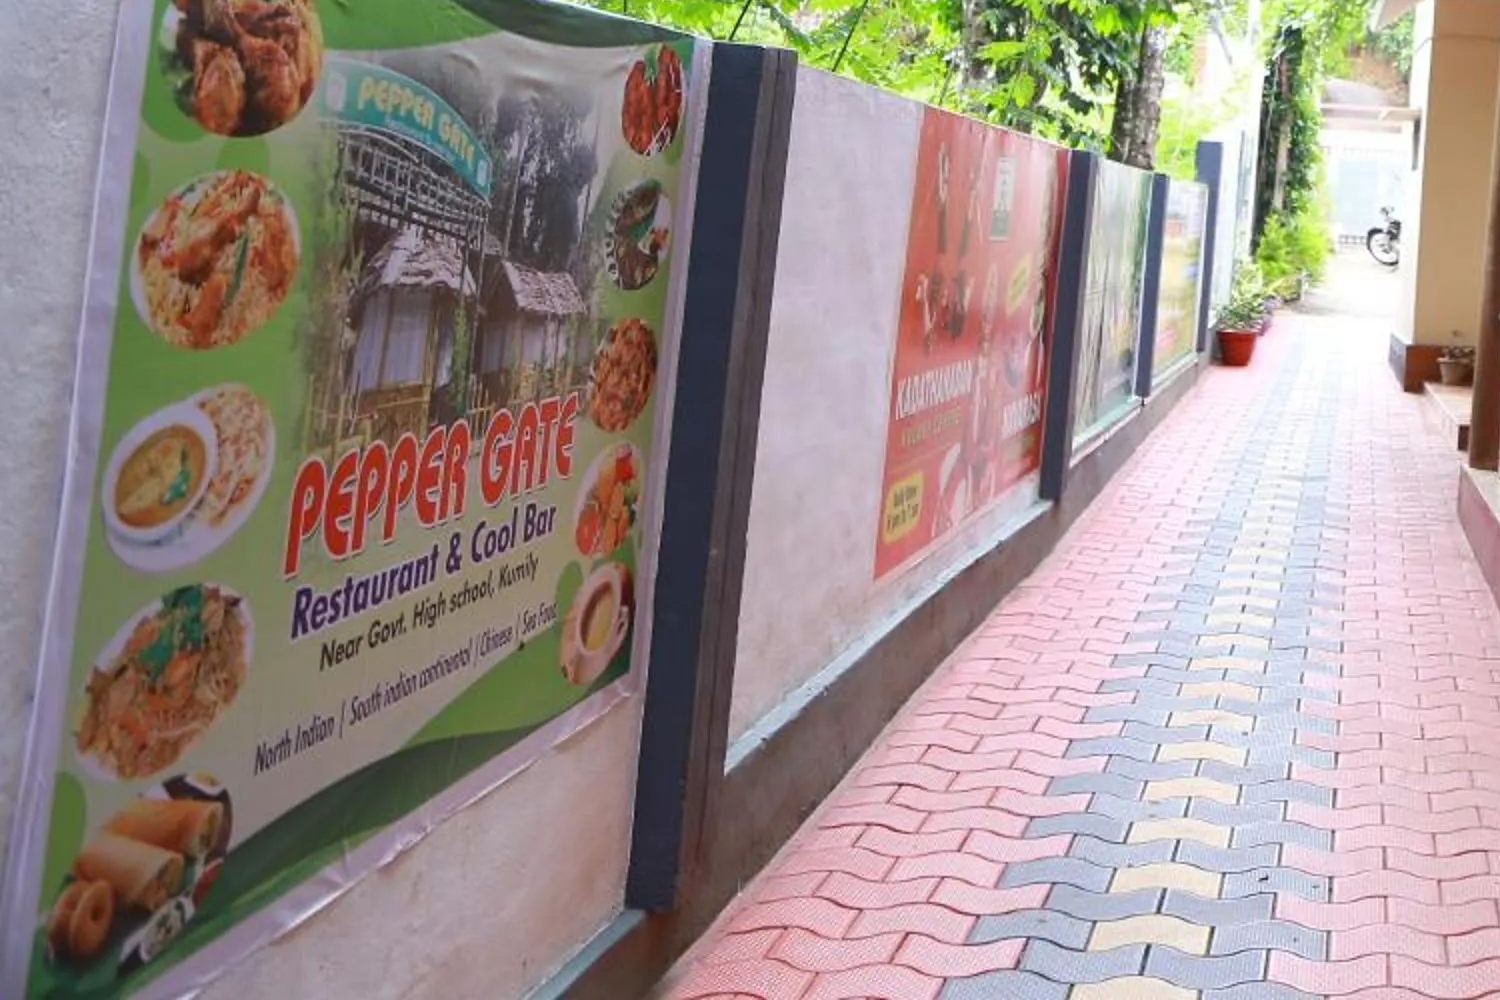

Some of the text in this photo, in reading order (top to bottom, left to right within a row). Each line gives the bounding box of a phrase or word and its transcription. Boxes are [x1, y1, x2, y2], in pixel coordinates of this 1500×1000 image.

[284, 391, 578, 581] PEPPER GATE
[291, 503, 557, 639] Restaurant & Cool Bar
[319, 634, 363, 672] Near
[368, 612, 407, 649] Govt.
[412, 592, 446, 628] High
[449, 570, 495, 612] school,
[254, 729, 292, 776] North
[295, 715, 334, 755] Indian
[350, 683, 381, 726] South
